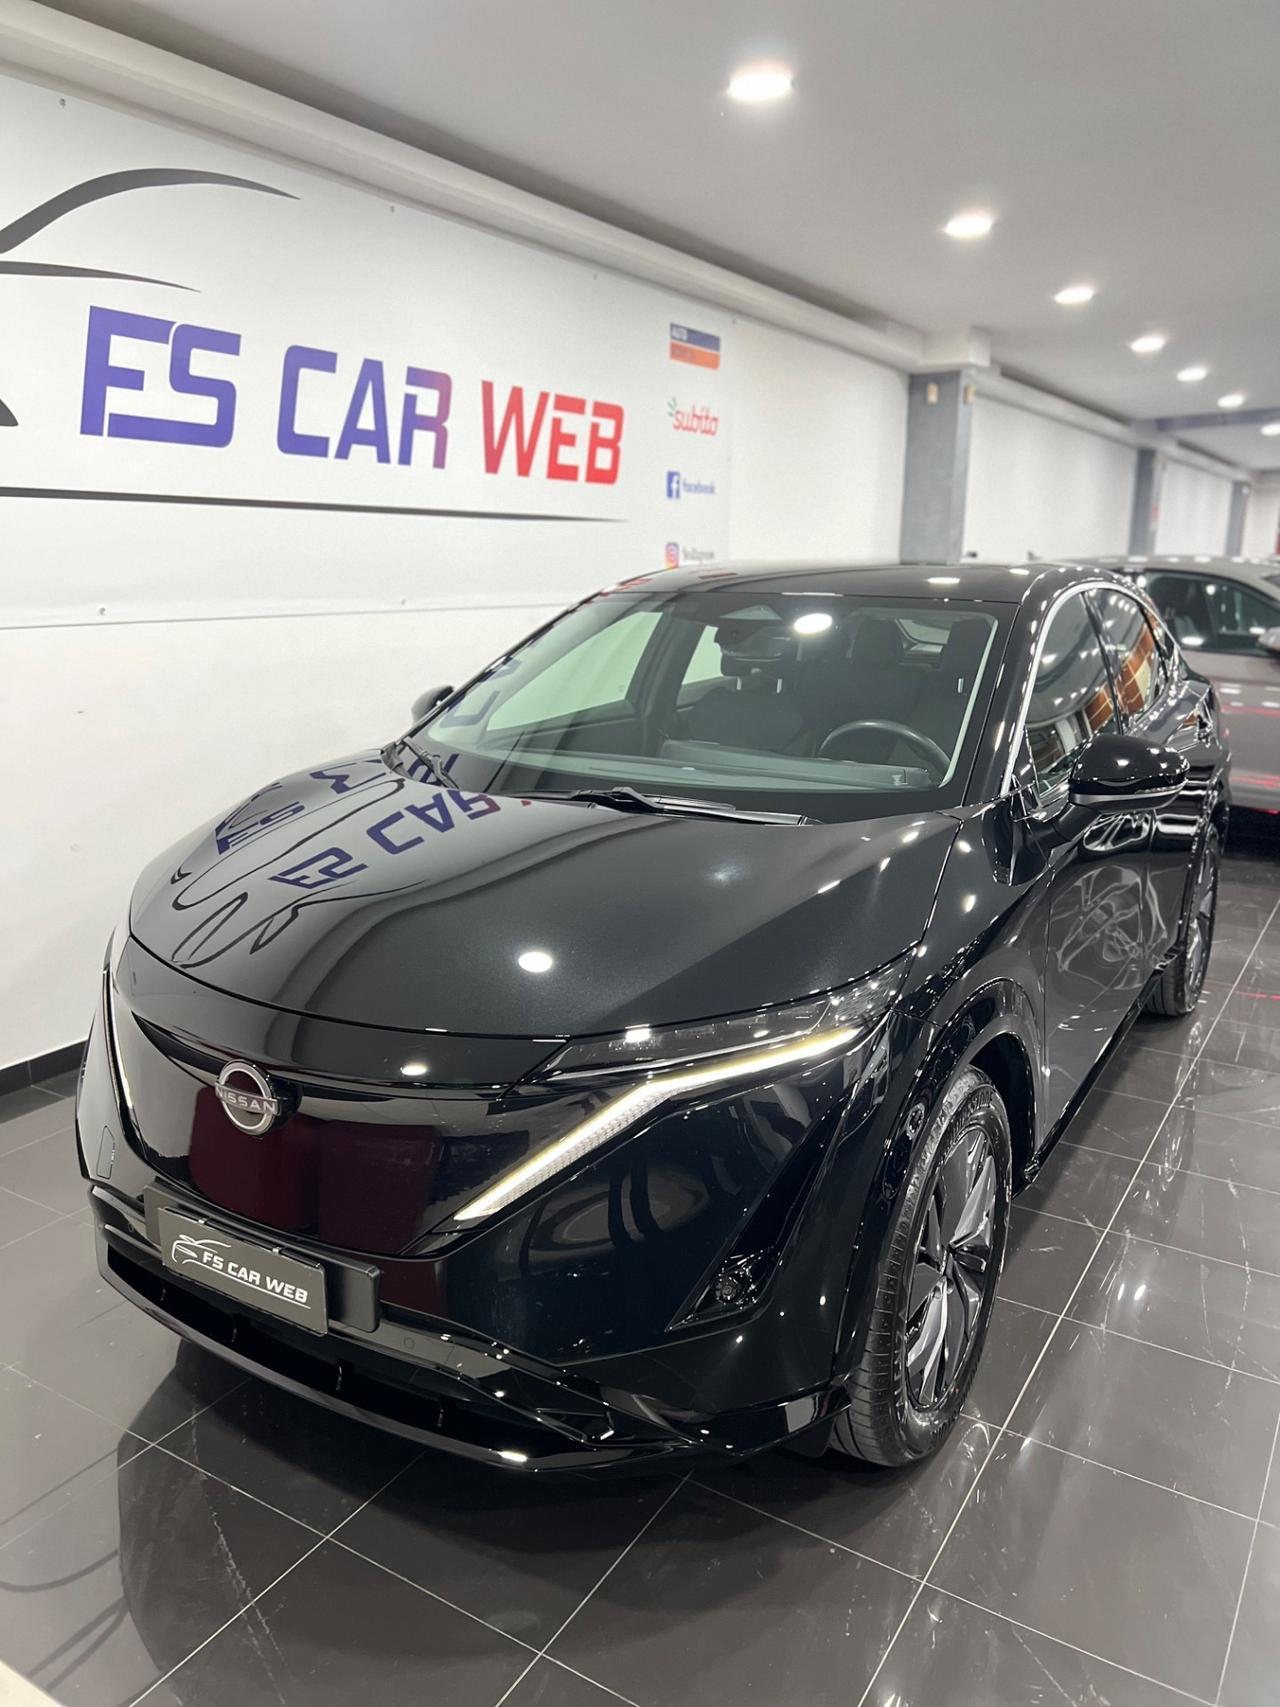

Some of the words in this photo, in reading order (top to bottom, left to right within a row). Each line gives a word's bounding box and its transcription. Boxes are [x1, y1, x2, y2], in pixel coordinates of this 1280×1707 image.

[277, 345, 452, 469] CAR
[481, 379, 625, 485] WEB
[673, 404, 719, 436] subito
[214, 1084, 277, 1112] NISSAN
[228, 1262, 260, 1286] CAR
[265, 1276, 308, 1304] WEB
